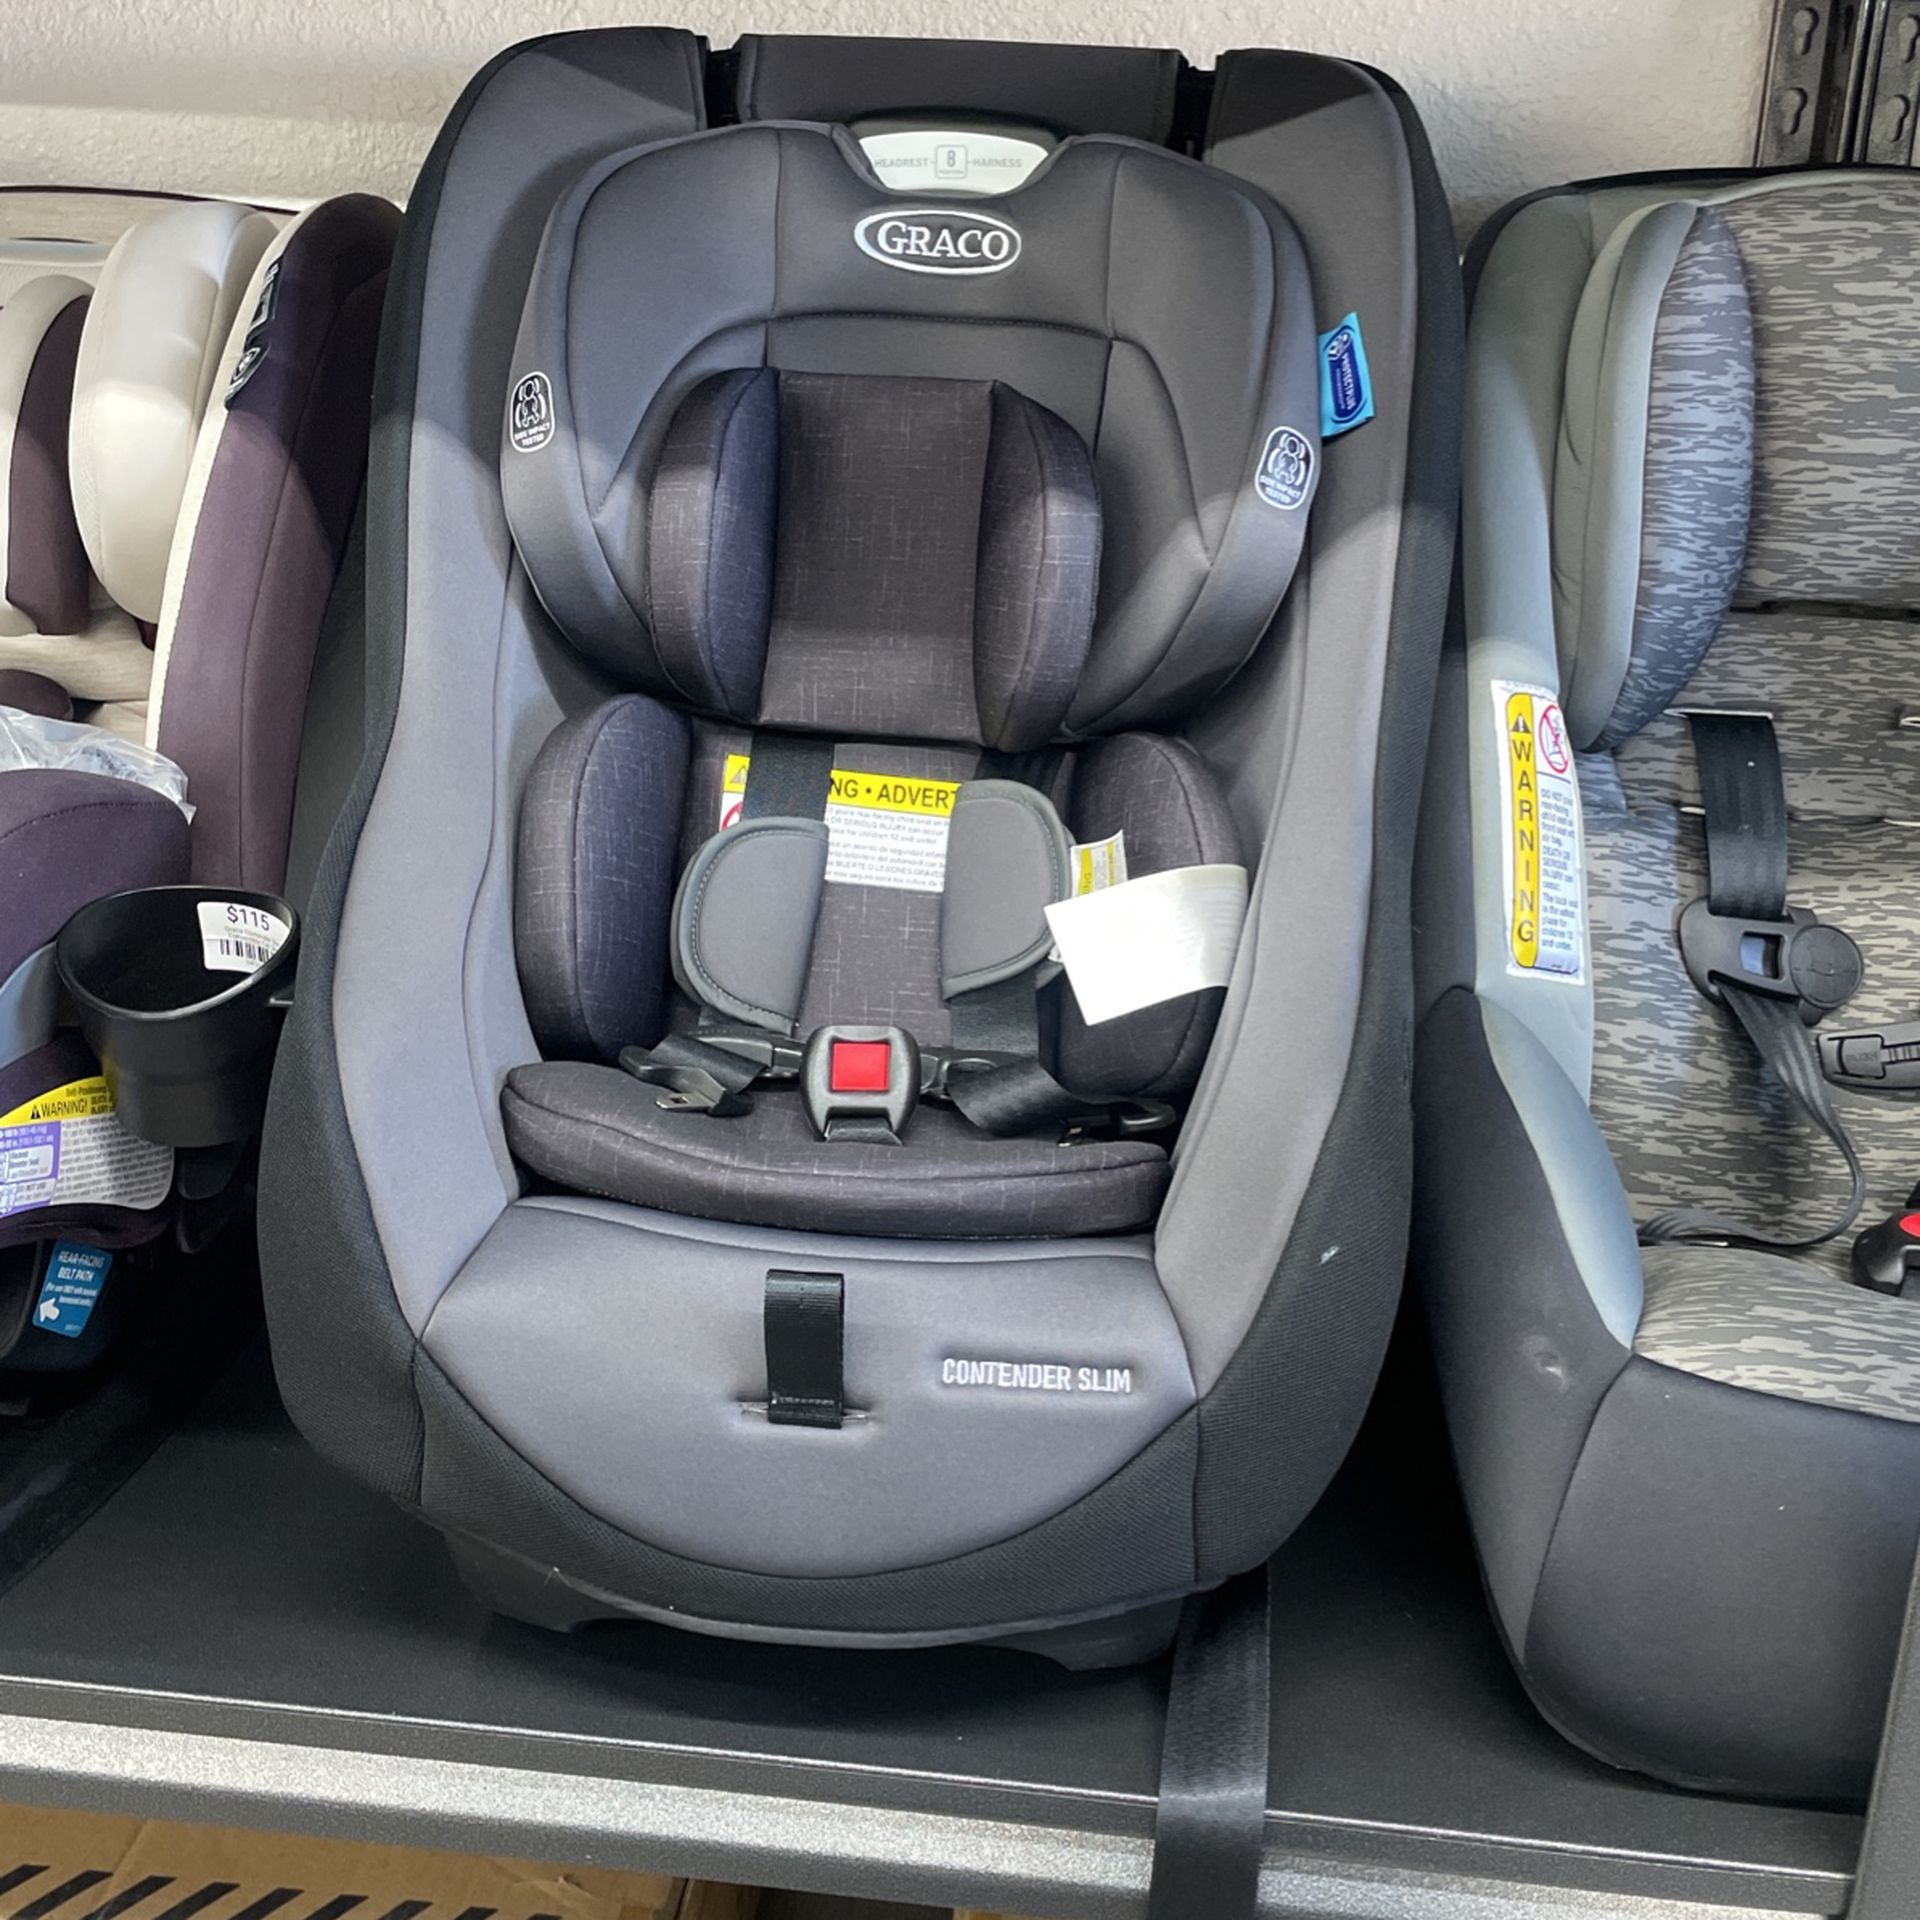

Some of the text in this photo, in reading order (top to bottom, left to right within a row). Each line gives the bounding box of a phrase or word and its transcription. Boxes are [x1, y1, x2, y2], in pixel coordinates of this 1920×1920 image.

[874, 149, 1023, 168] HEADREST 8 HARNESS
[877, 220, 1010, 260] GRACO
[1512, 739, 1534, 943] WARNING
[226, 904, 270, 932] $115
[41, 1099, 88, 1117] WARNING!
[58, 1250, 105, 1269] REAR-FACING
[57, 1266, 95, 1282] BELT PATH
[942, 1357, 1132, 1394] CONTENDER SLIM
